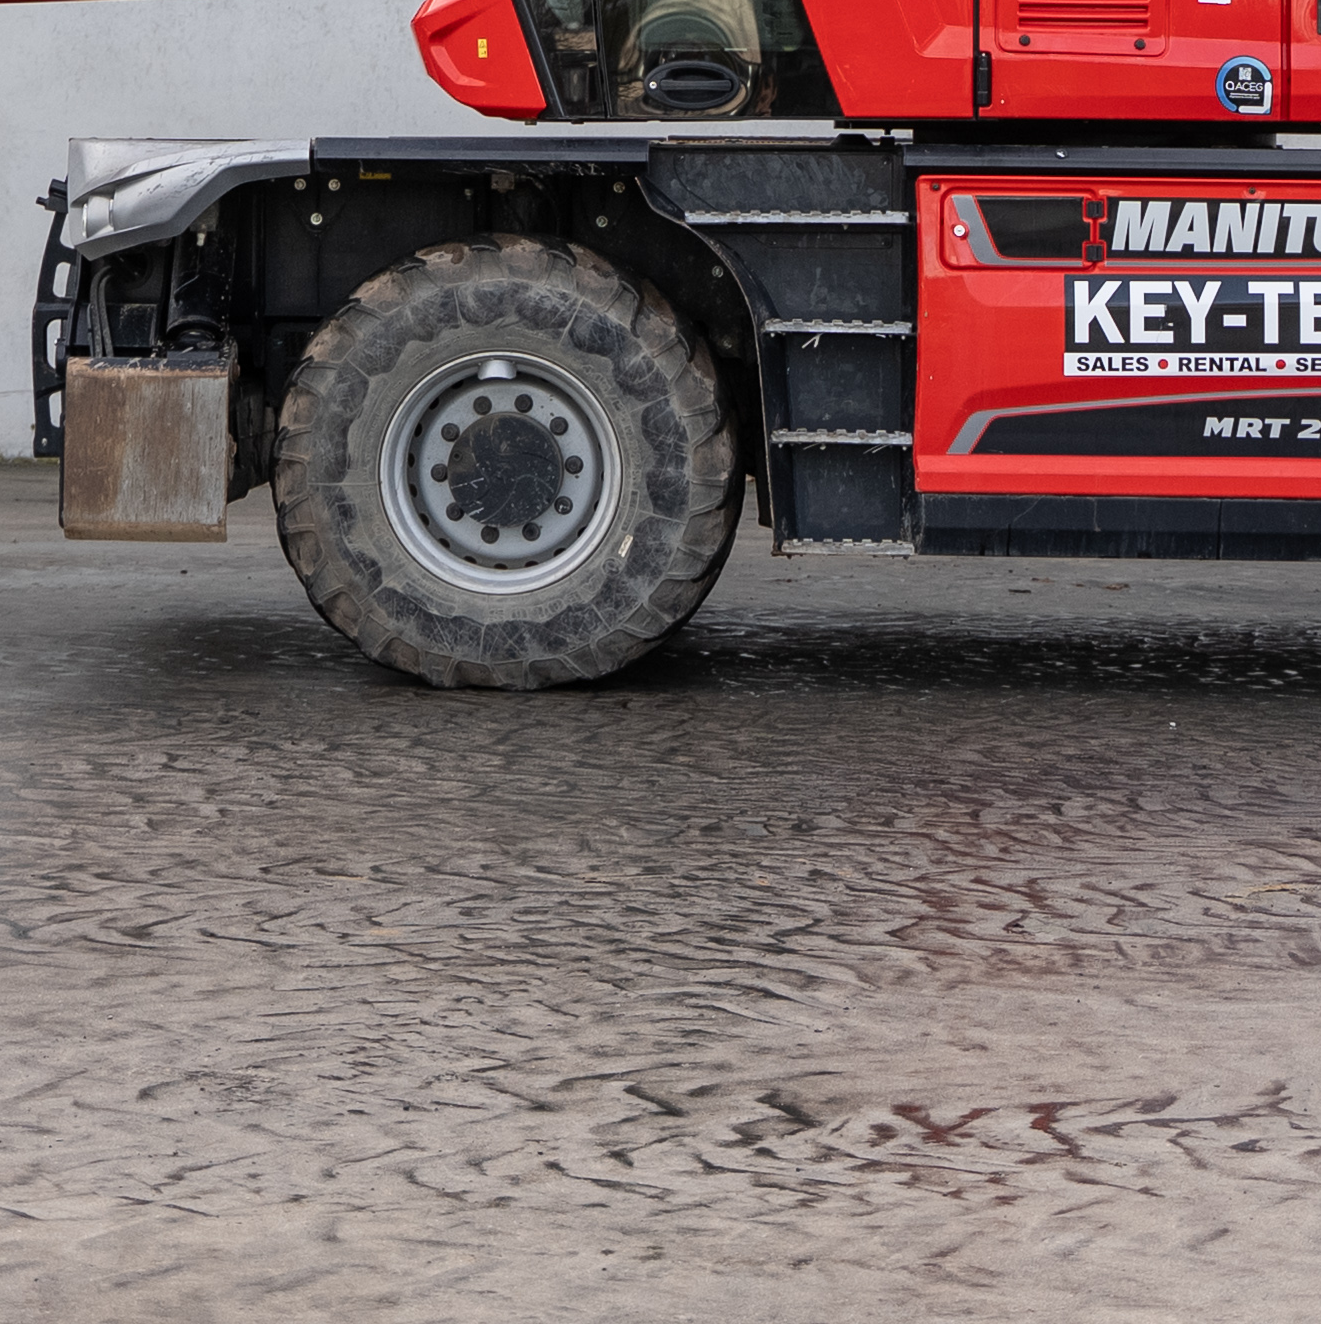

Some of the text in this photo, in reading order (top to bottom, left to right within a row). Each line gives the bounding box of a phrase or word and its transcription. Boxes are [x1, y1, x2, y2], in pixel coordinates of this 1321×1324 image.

[1076, 356, 1149, 372] SALES
[1178, 356, 1267, 372] RENTAL
[1203, 416, 1291, 439] MRT
